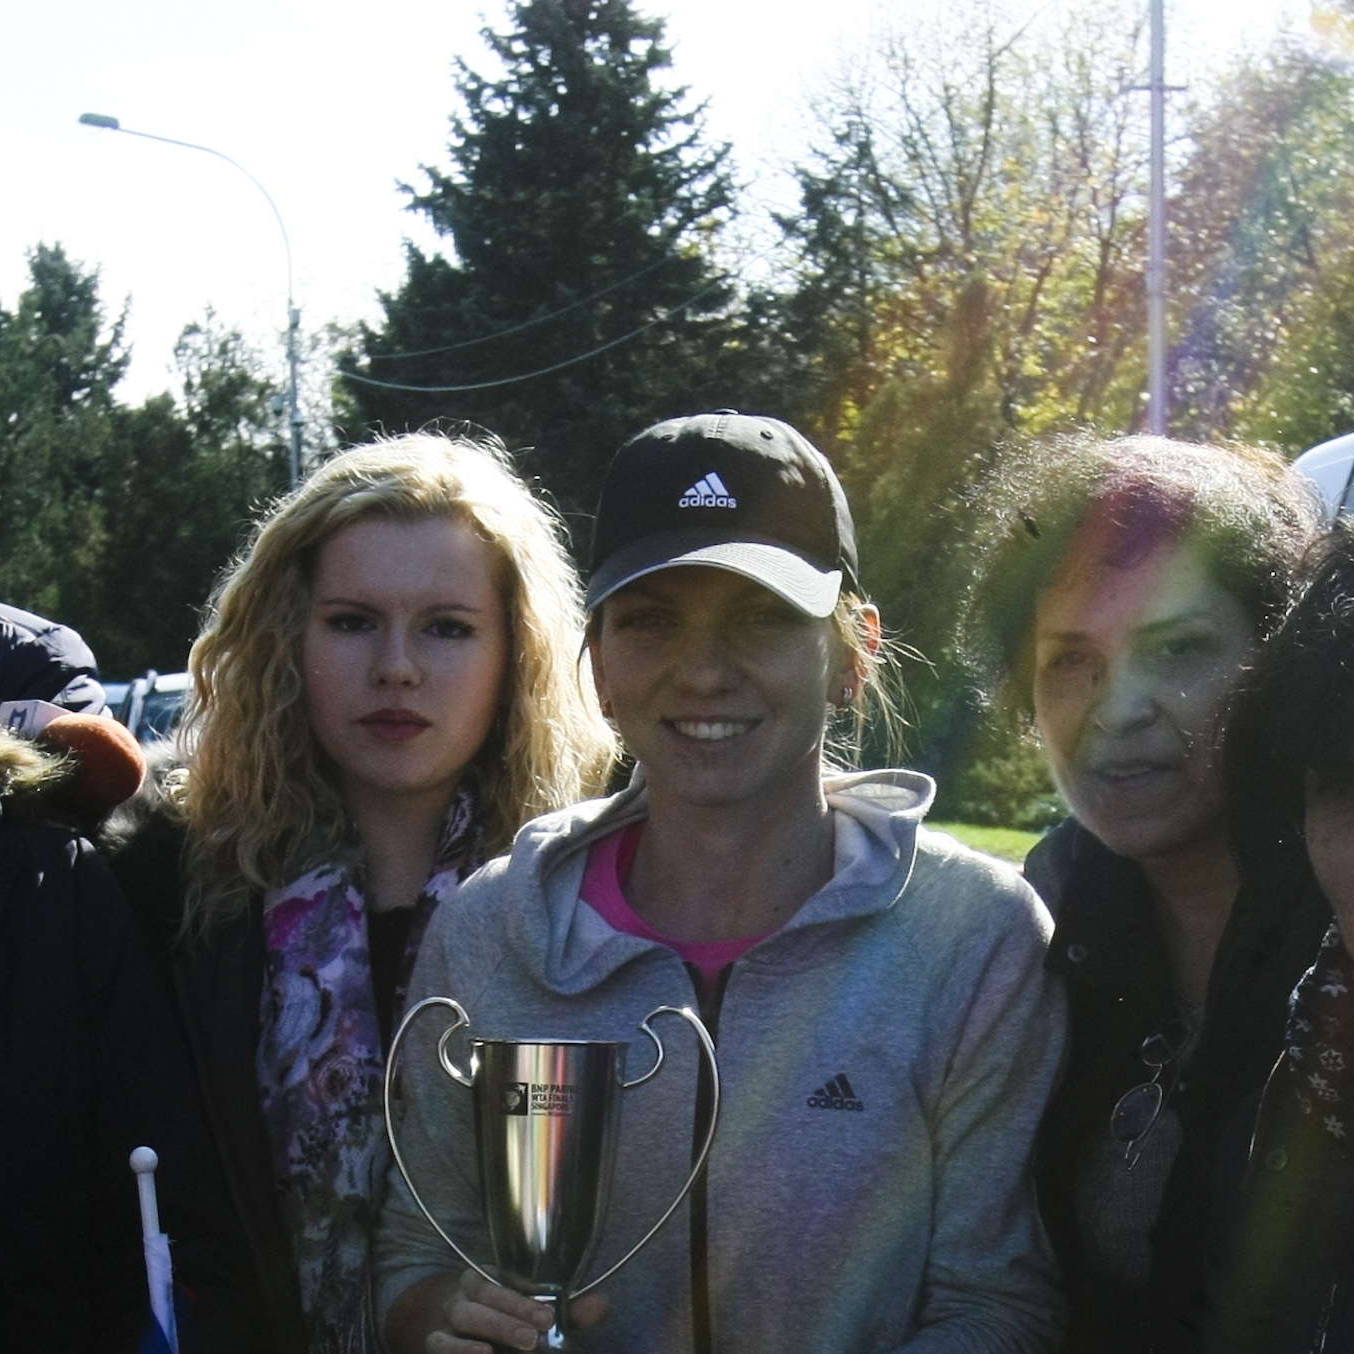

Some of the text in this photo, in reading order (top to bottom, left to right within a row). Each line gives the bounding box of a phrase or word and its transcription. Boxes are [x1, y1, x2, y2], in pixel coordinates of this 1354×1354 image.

[678, 494, 737, 509] adidas
[531, 1084, 549, 1093] BNP
[806, 1096, 865, 1112] adidas
